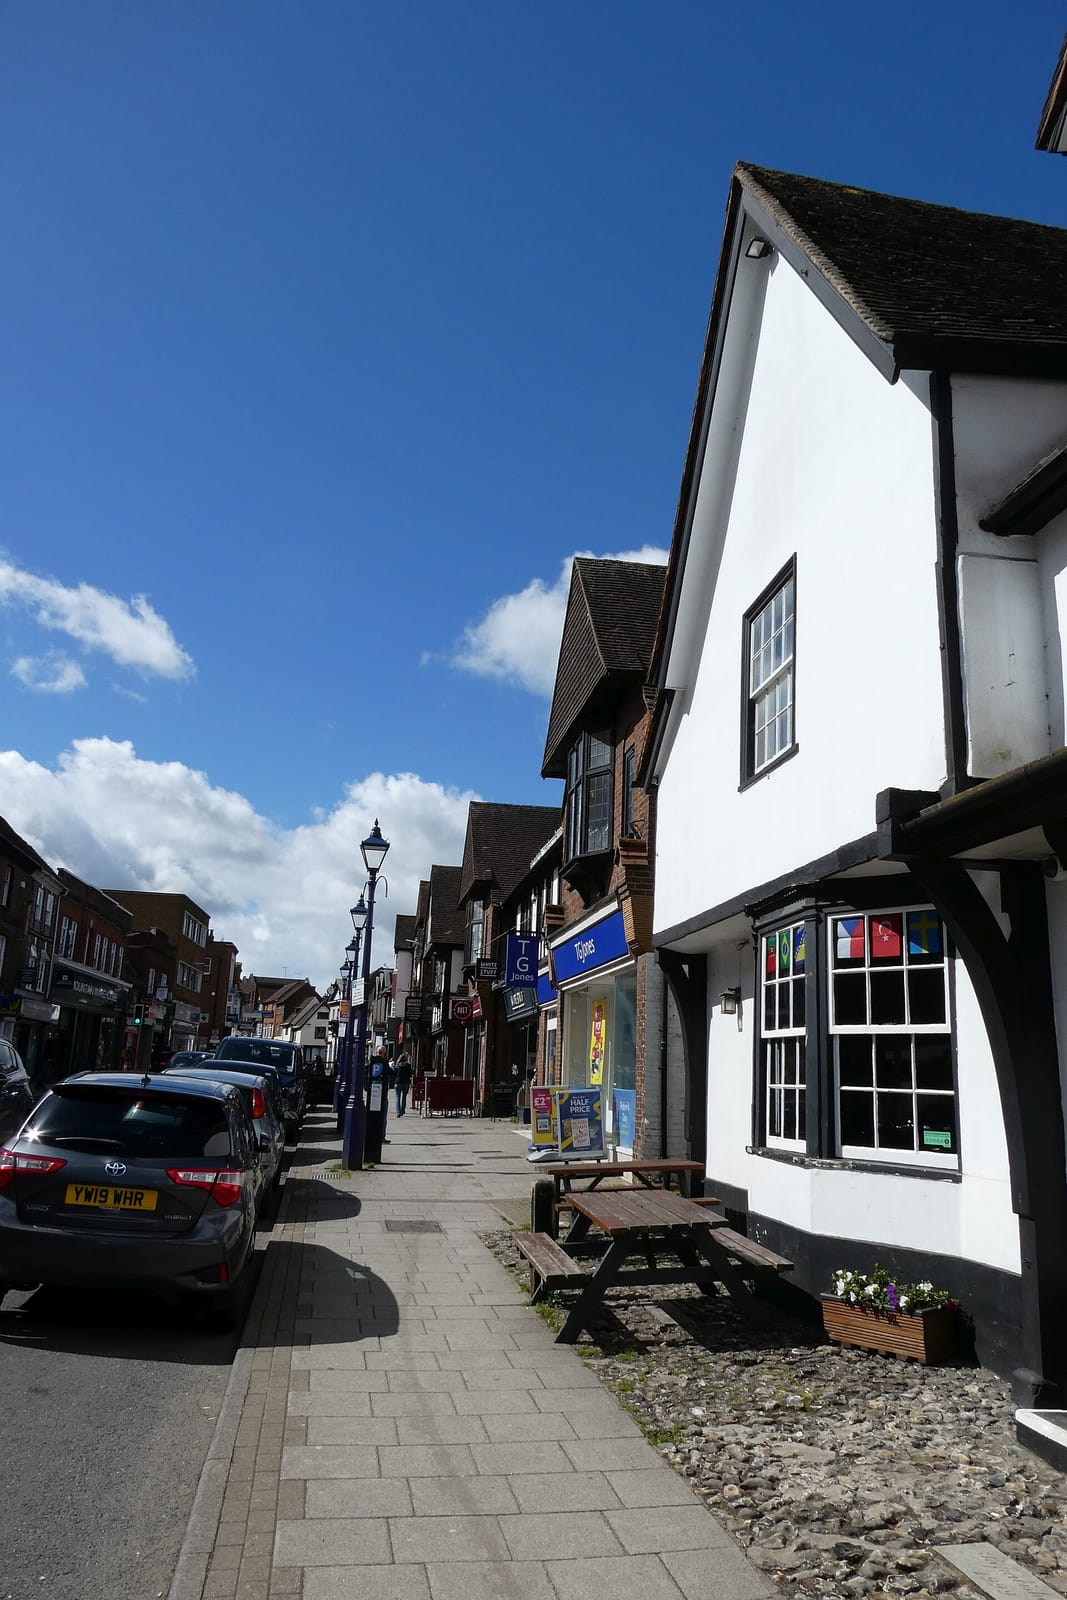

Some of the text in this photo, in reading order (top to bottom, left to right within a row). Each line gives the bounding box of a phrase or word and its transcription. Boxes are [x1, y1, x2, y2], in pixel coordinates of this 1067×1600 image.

[518, 940, 530, 955] T
[517, 957, 529, 972] G
[510, 972, 534, 982] Jones
[570, 1098, 590, 1106] HALF
[569, 1105, 591, 1114] PRICE
[74, 1186, 144, 1206] YW19 WHR
